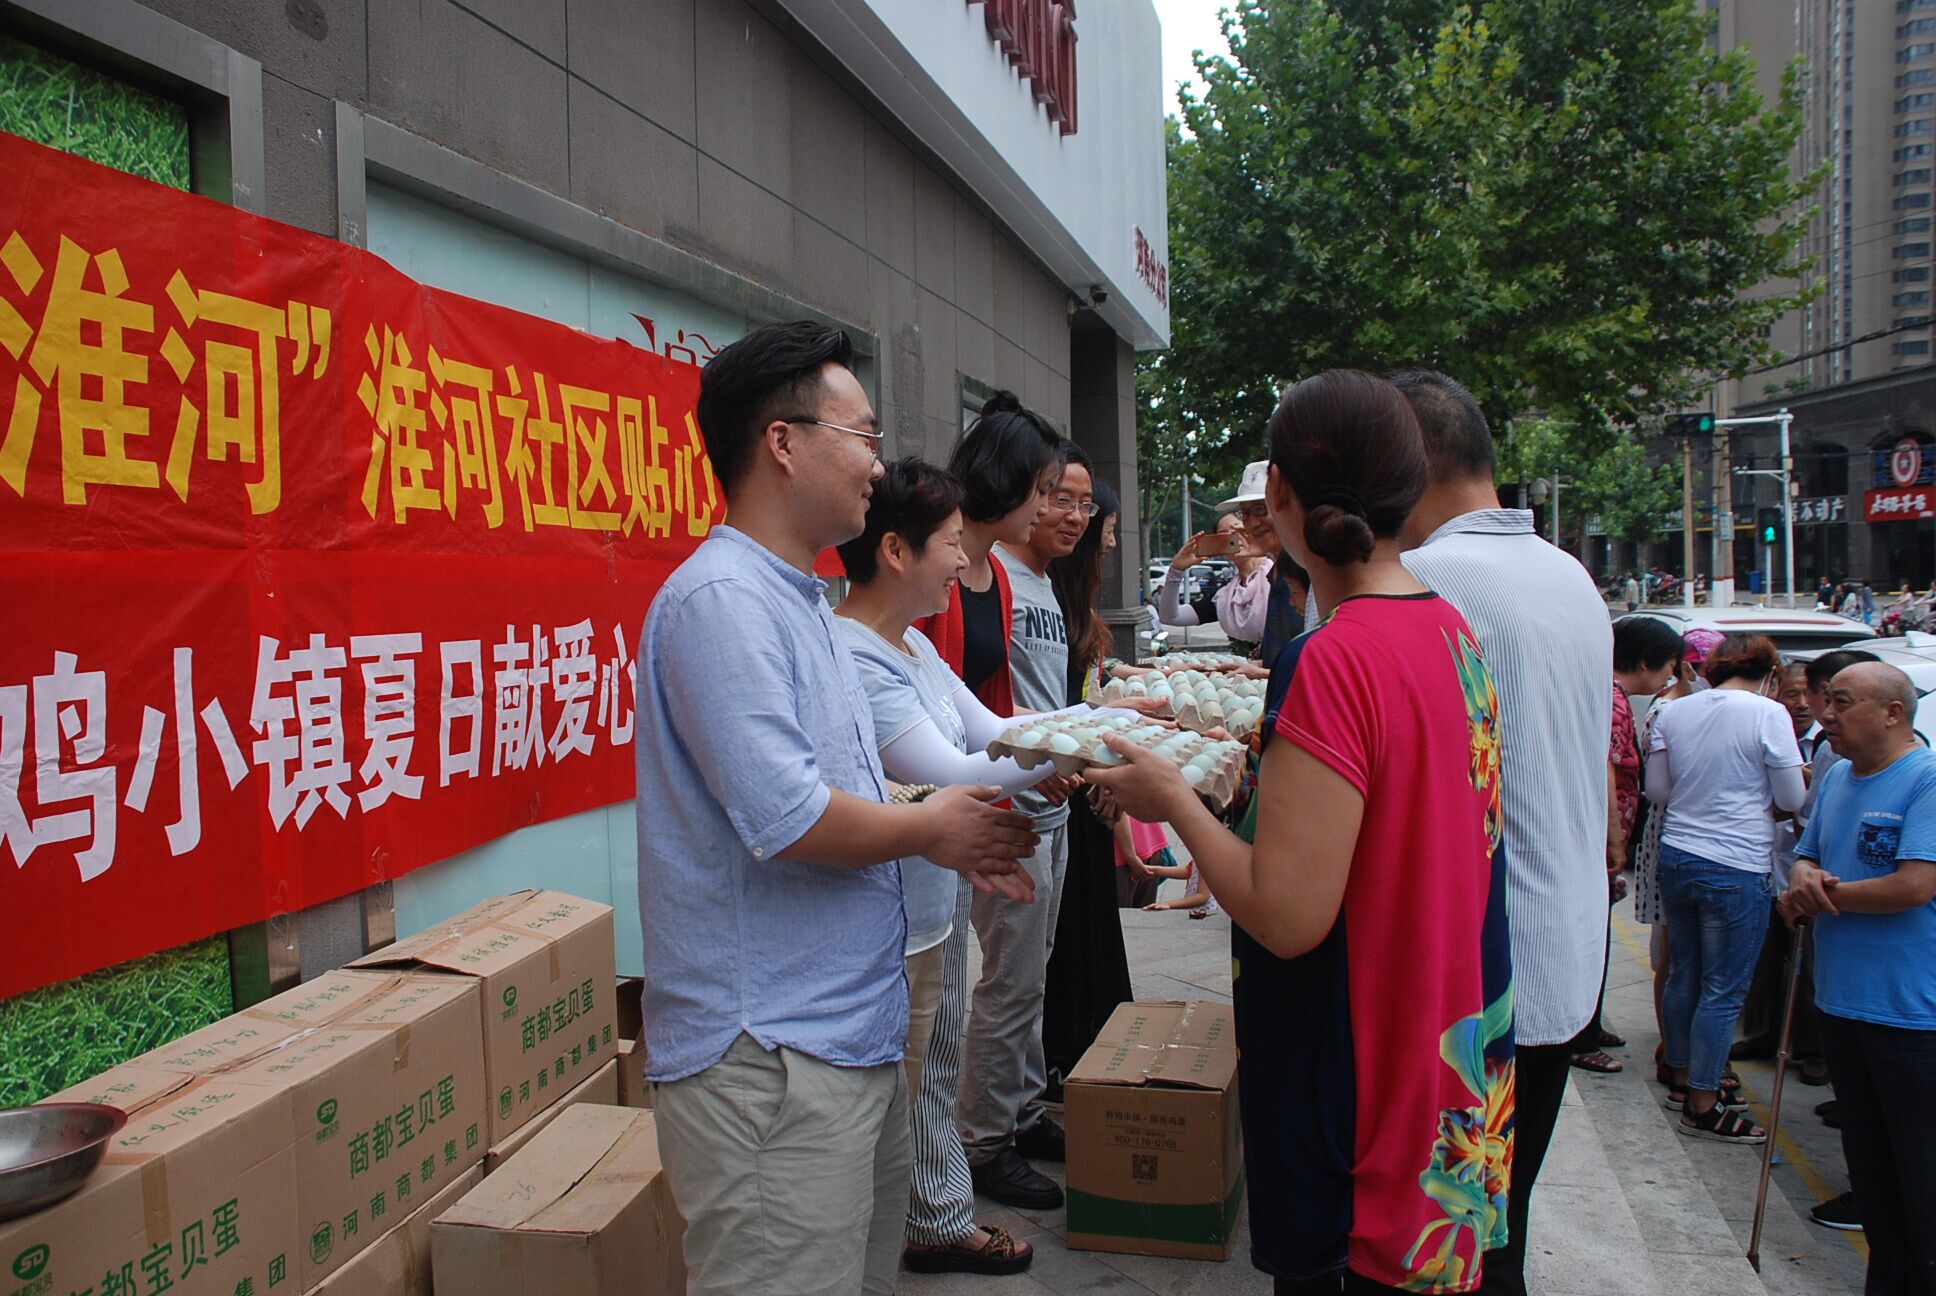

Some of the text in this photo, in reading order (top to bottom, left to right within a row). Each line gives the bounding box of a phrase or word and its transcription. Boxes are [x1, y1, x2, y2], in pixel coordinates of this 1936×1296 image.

[1024, 606, 1066, 644] NEVE
[521, 978, 594, 1054] 商都宝贝蛋
[519, 1024, 612, 1105] 河南商都集团
[348, 1074, 455, 1180] 商都宝贝蛋
[343, 1122, 478, 1241] 河南商都集团
[70, 1197, 240, 1296] 都宝贝蛋
